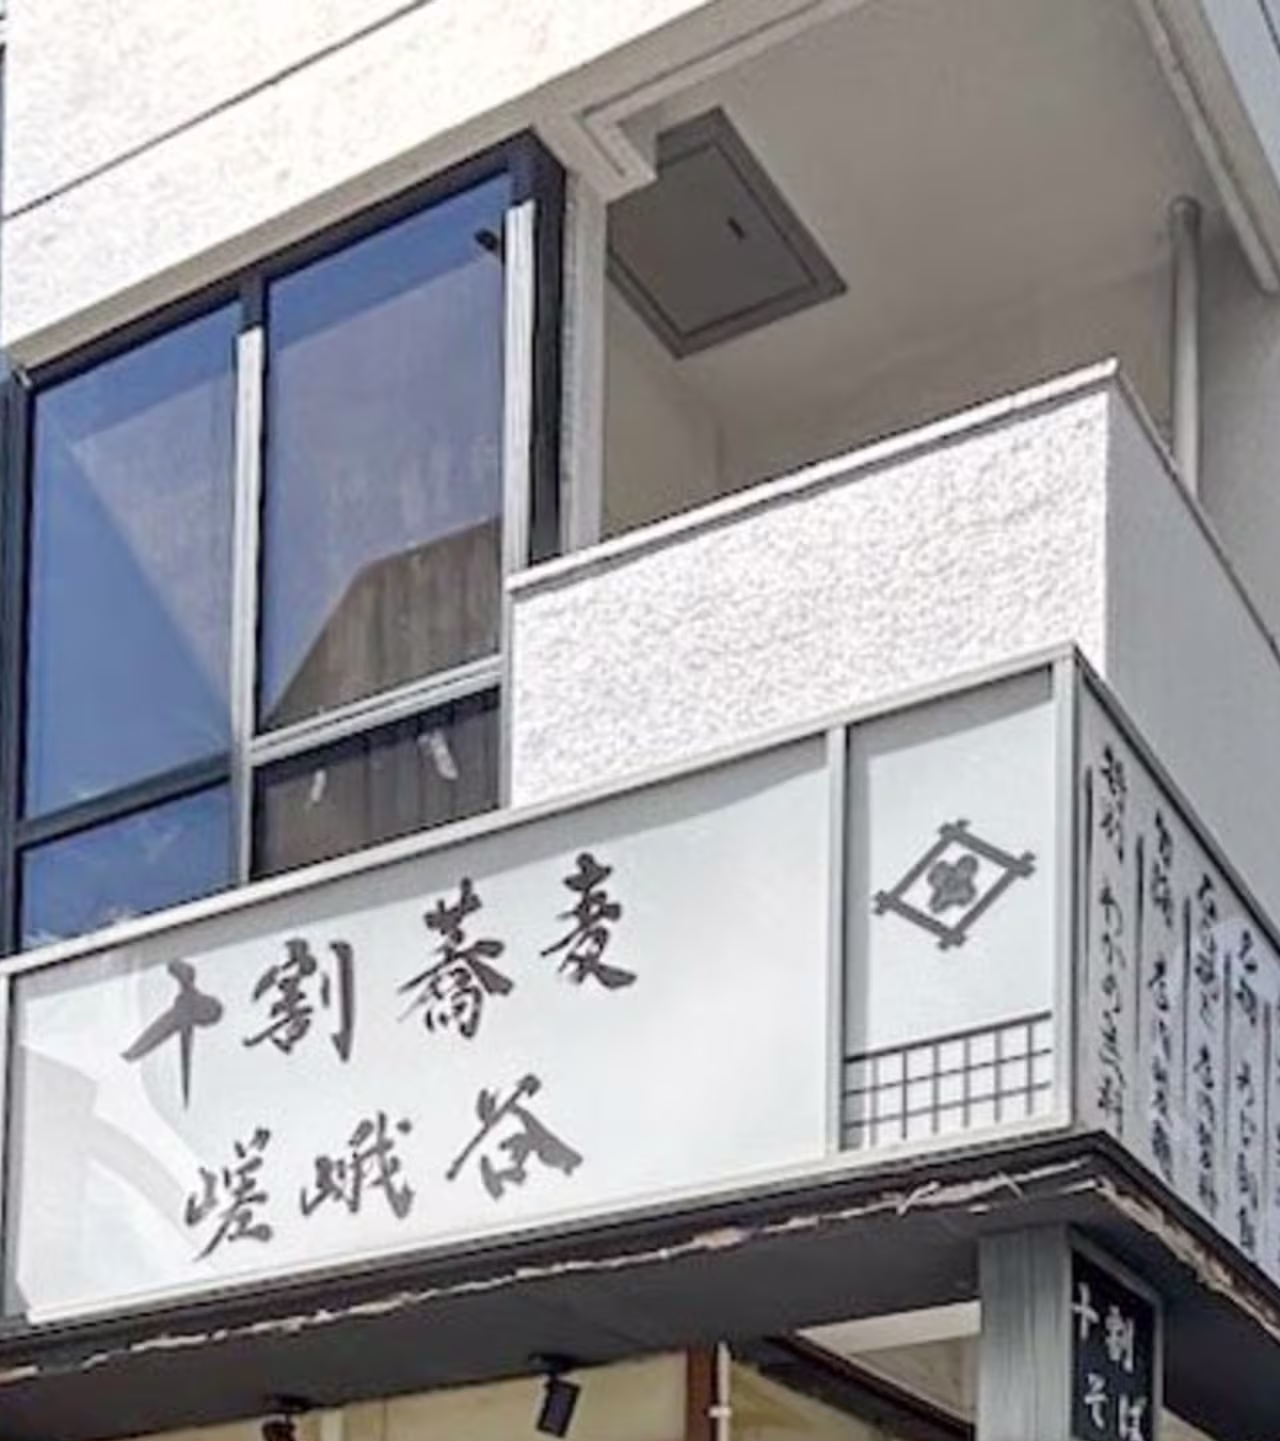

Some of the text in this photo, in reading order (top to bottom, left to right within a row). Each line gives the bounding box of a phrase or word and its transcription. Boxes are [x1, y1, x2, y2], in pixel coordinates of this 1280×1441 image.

[120, 851, 639, 1110] 十割蕎麦
[186, 1072, 584, 1263] 嵯峨谷
[1072, 1282, 1135, 1374] 十割
